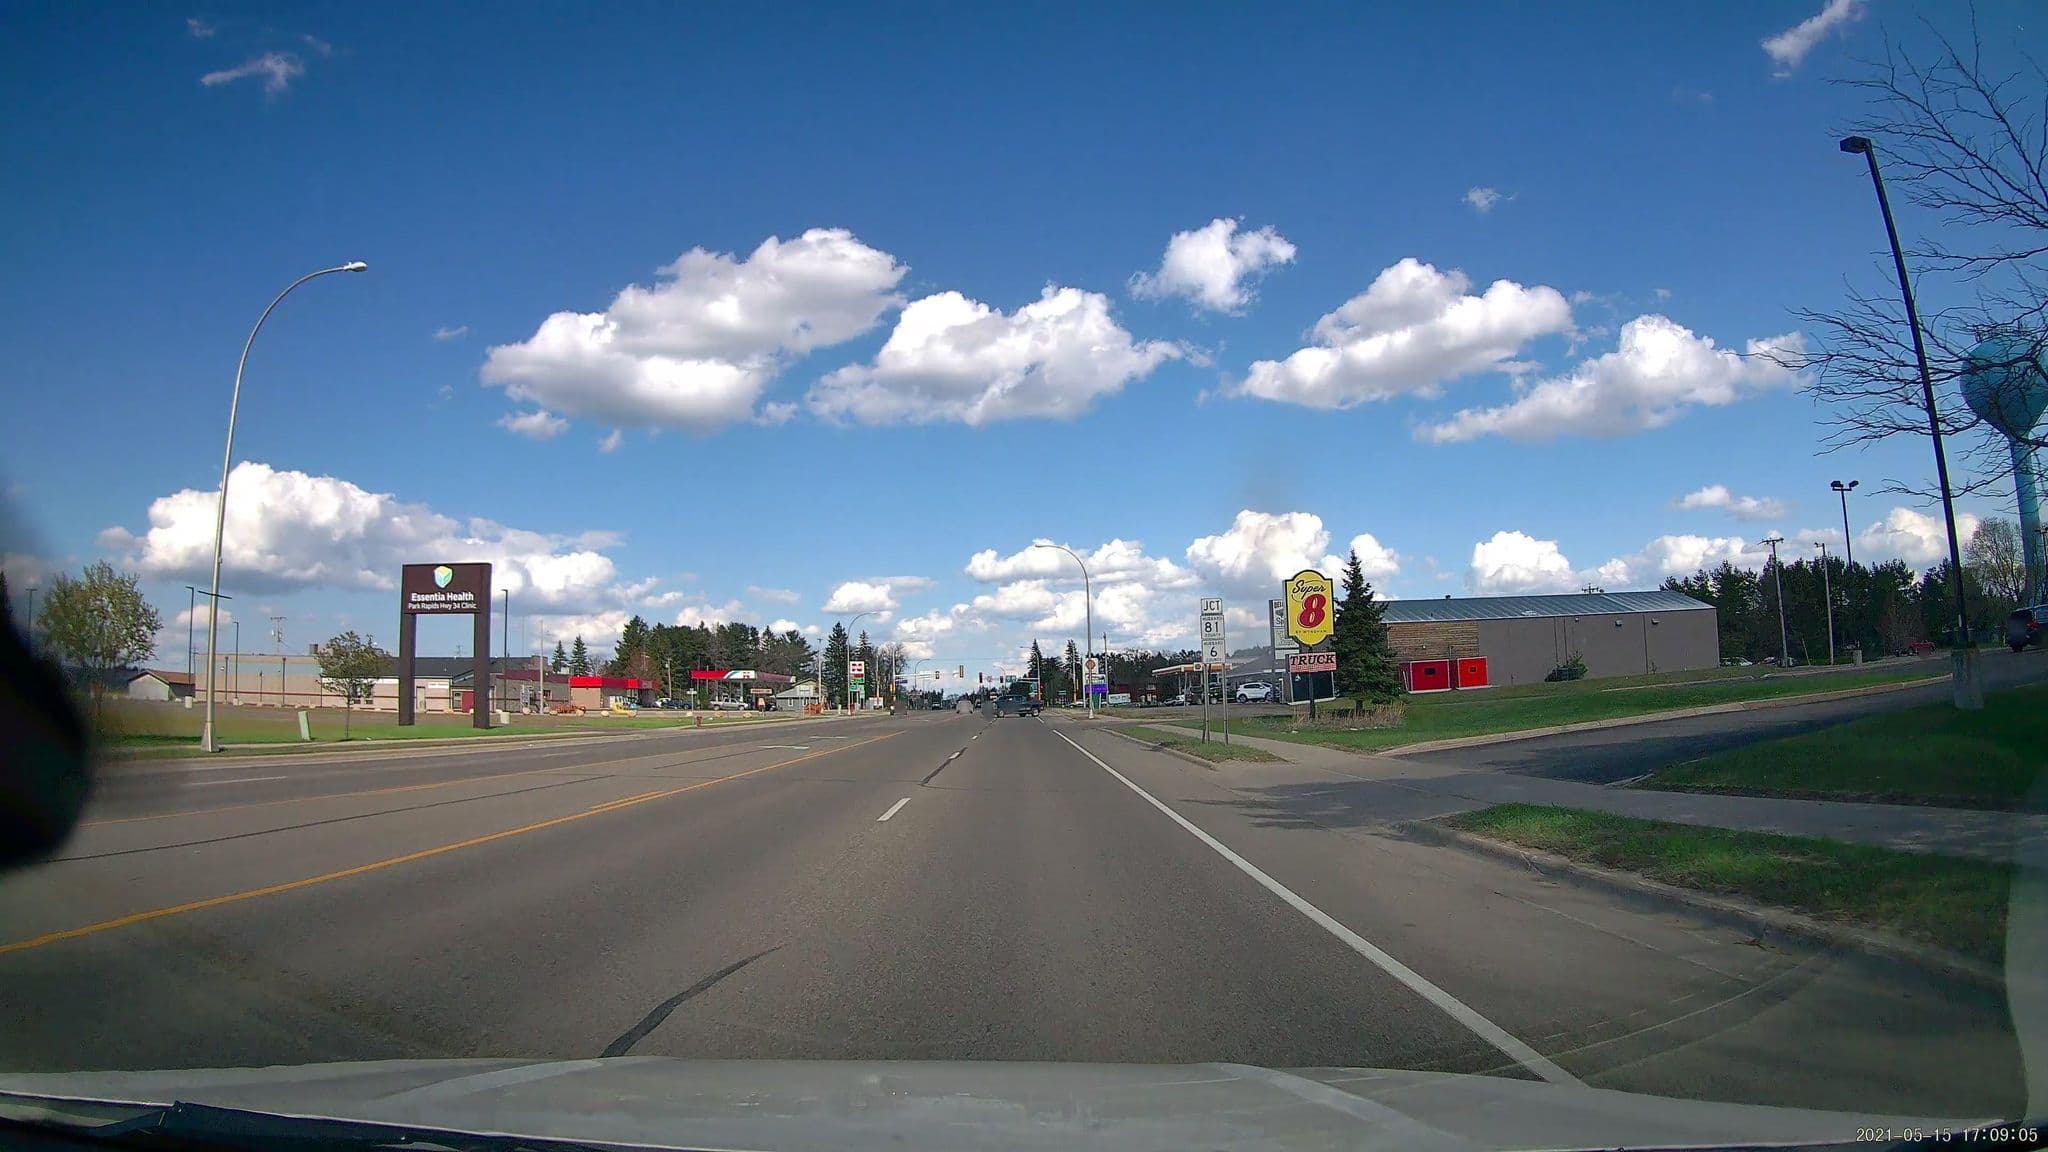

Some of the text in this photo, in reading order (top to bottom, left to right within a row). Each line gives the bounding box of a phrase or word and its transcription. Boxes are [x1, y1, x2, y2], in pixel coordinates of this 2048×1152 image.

[1292, 579, 1326, 600] Super
[411, 592, 474, 601] Essentia Health
[421, 602, 439, 610] Rapids
[440, 602, 452, 610] Hwy
[1203, 600, 1220, 611] JCT
[1297, 593, 1327, 629] 8
[1204, 621, 1219, 633] 81
[1210, 646, 1218, 657] 6
[1290, 653, 1335, 667] TRUCK
